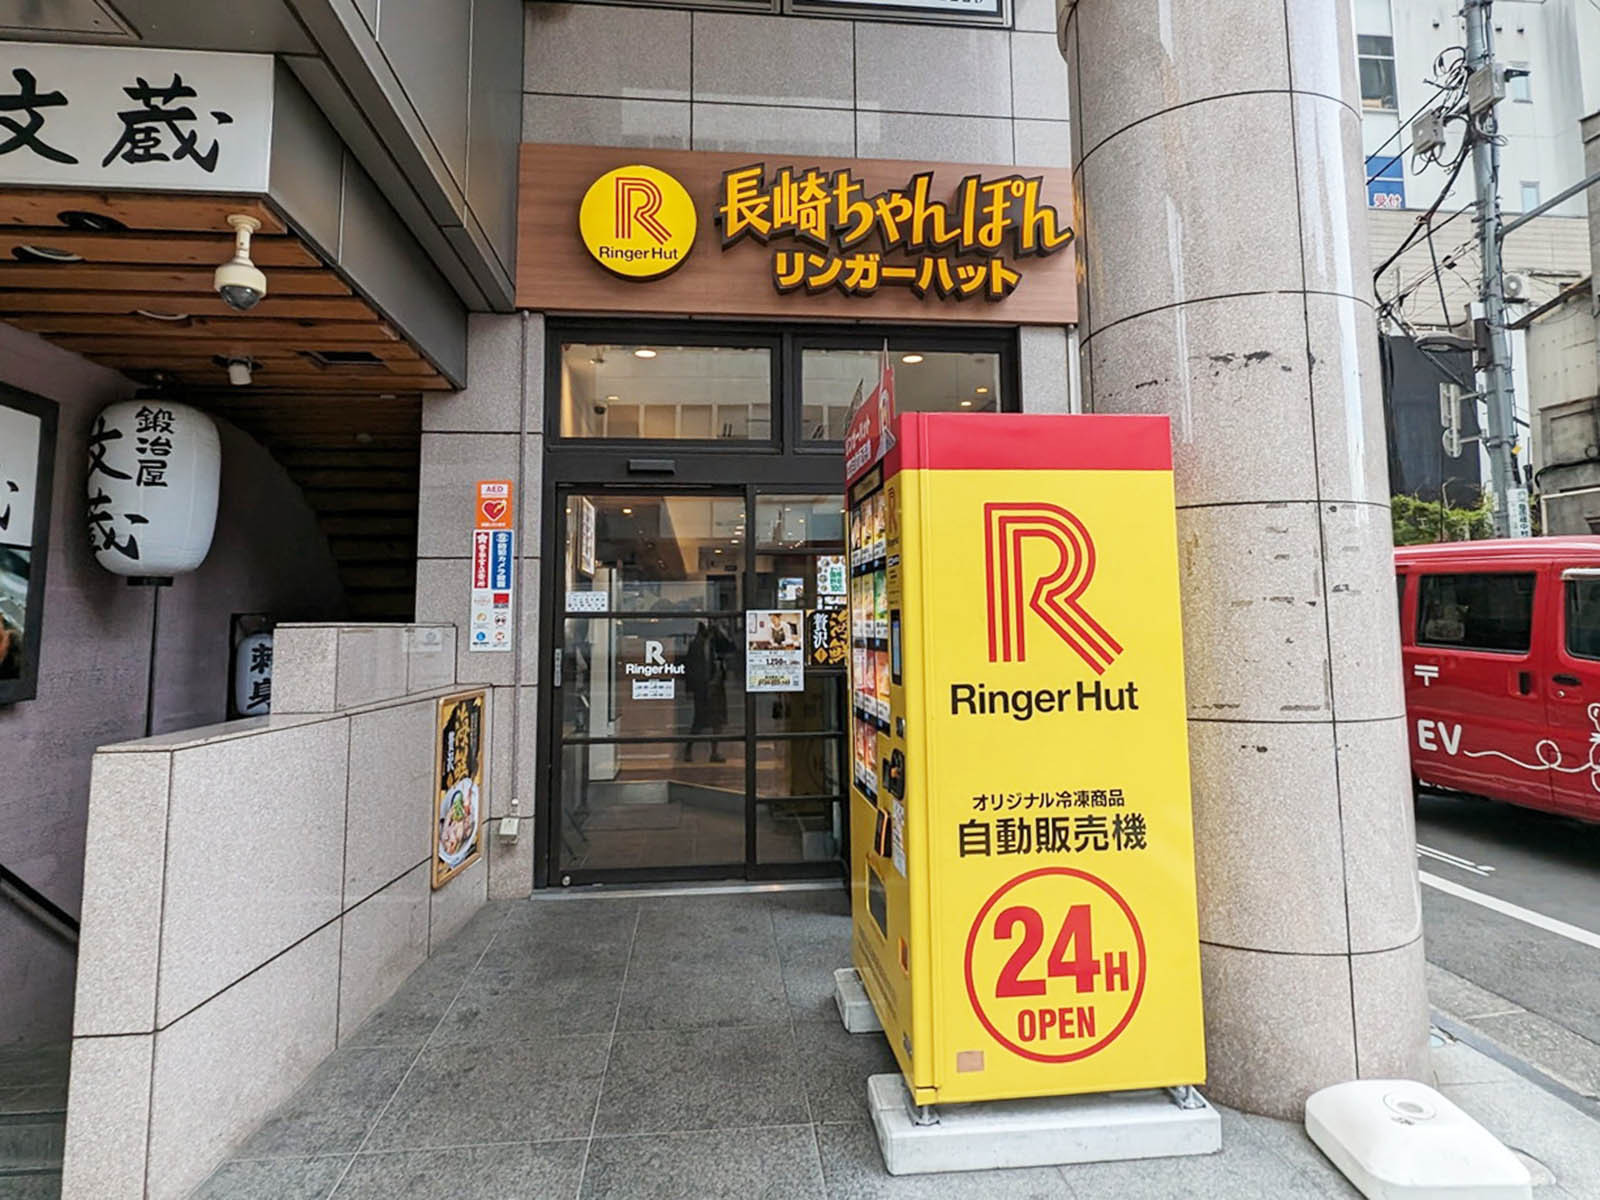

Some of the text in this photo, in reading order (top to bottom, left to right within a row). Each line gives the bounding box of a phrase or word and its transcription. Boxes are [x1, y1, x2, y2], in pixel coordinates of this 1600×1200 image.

[0, 68, 233, 173] 文蔵
[615, 176, 673, 246] R
[717, 163, 1075, 252] 長崎ちゃんぽん
[774, 251, 1020, 296] リンガーハット
[135, 405, 176, 487] 鍛冶屋
[486, 485, 504, 493] AED
[983, 502, 1125, 676] R
[645, 640, 667, 665] R
[1417, 719, 1462, 756] EV
[972, 789, 1126, 812] オリジナル冷凍商品
[958, 812, 1148, 858] 自動販売機
[992, 903, 1131, 999] 24H
[1017, 1006, 1096, 1042] OPEN
